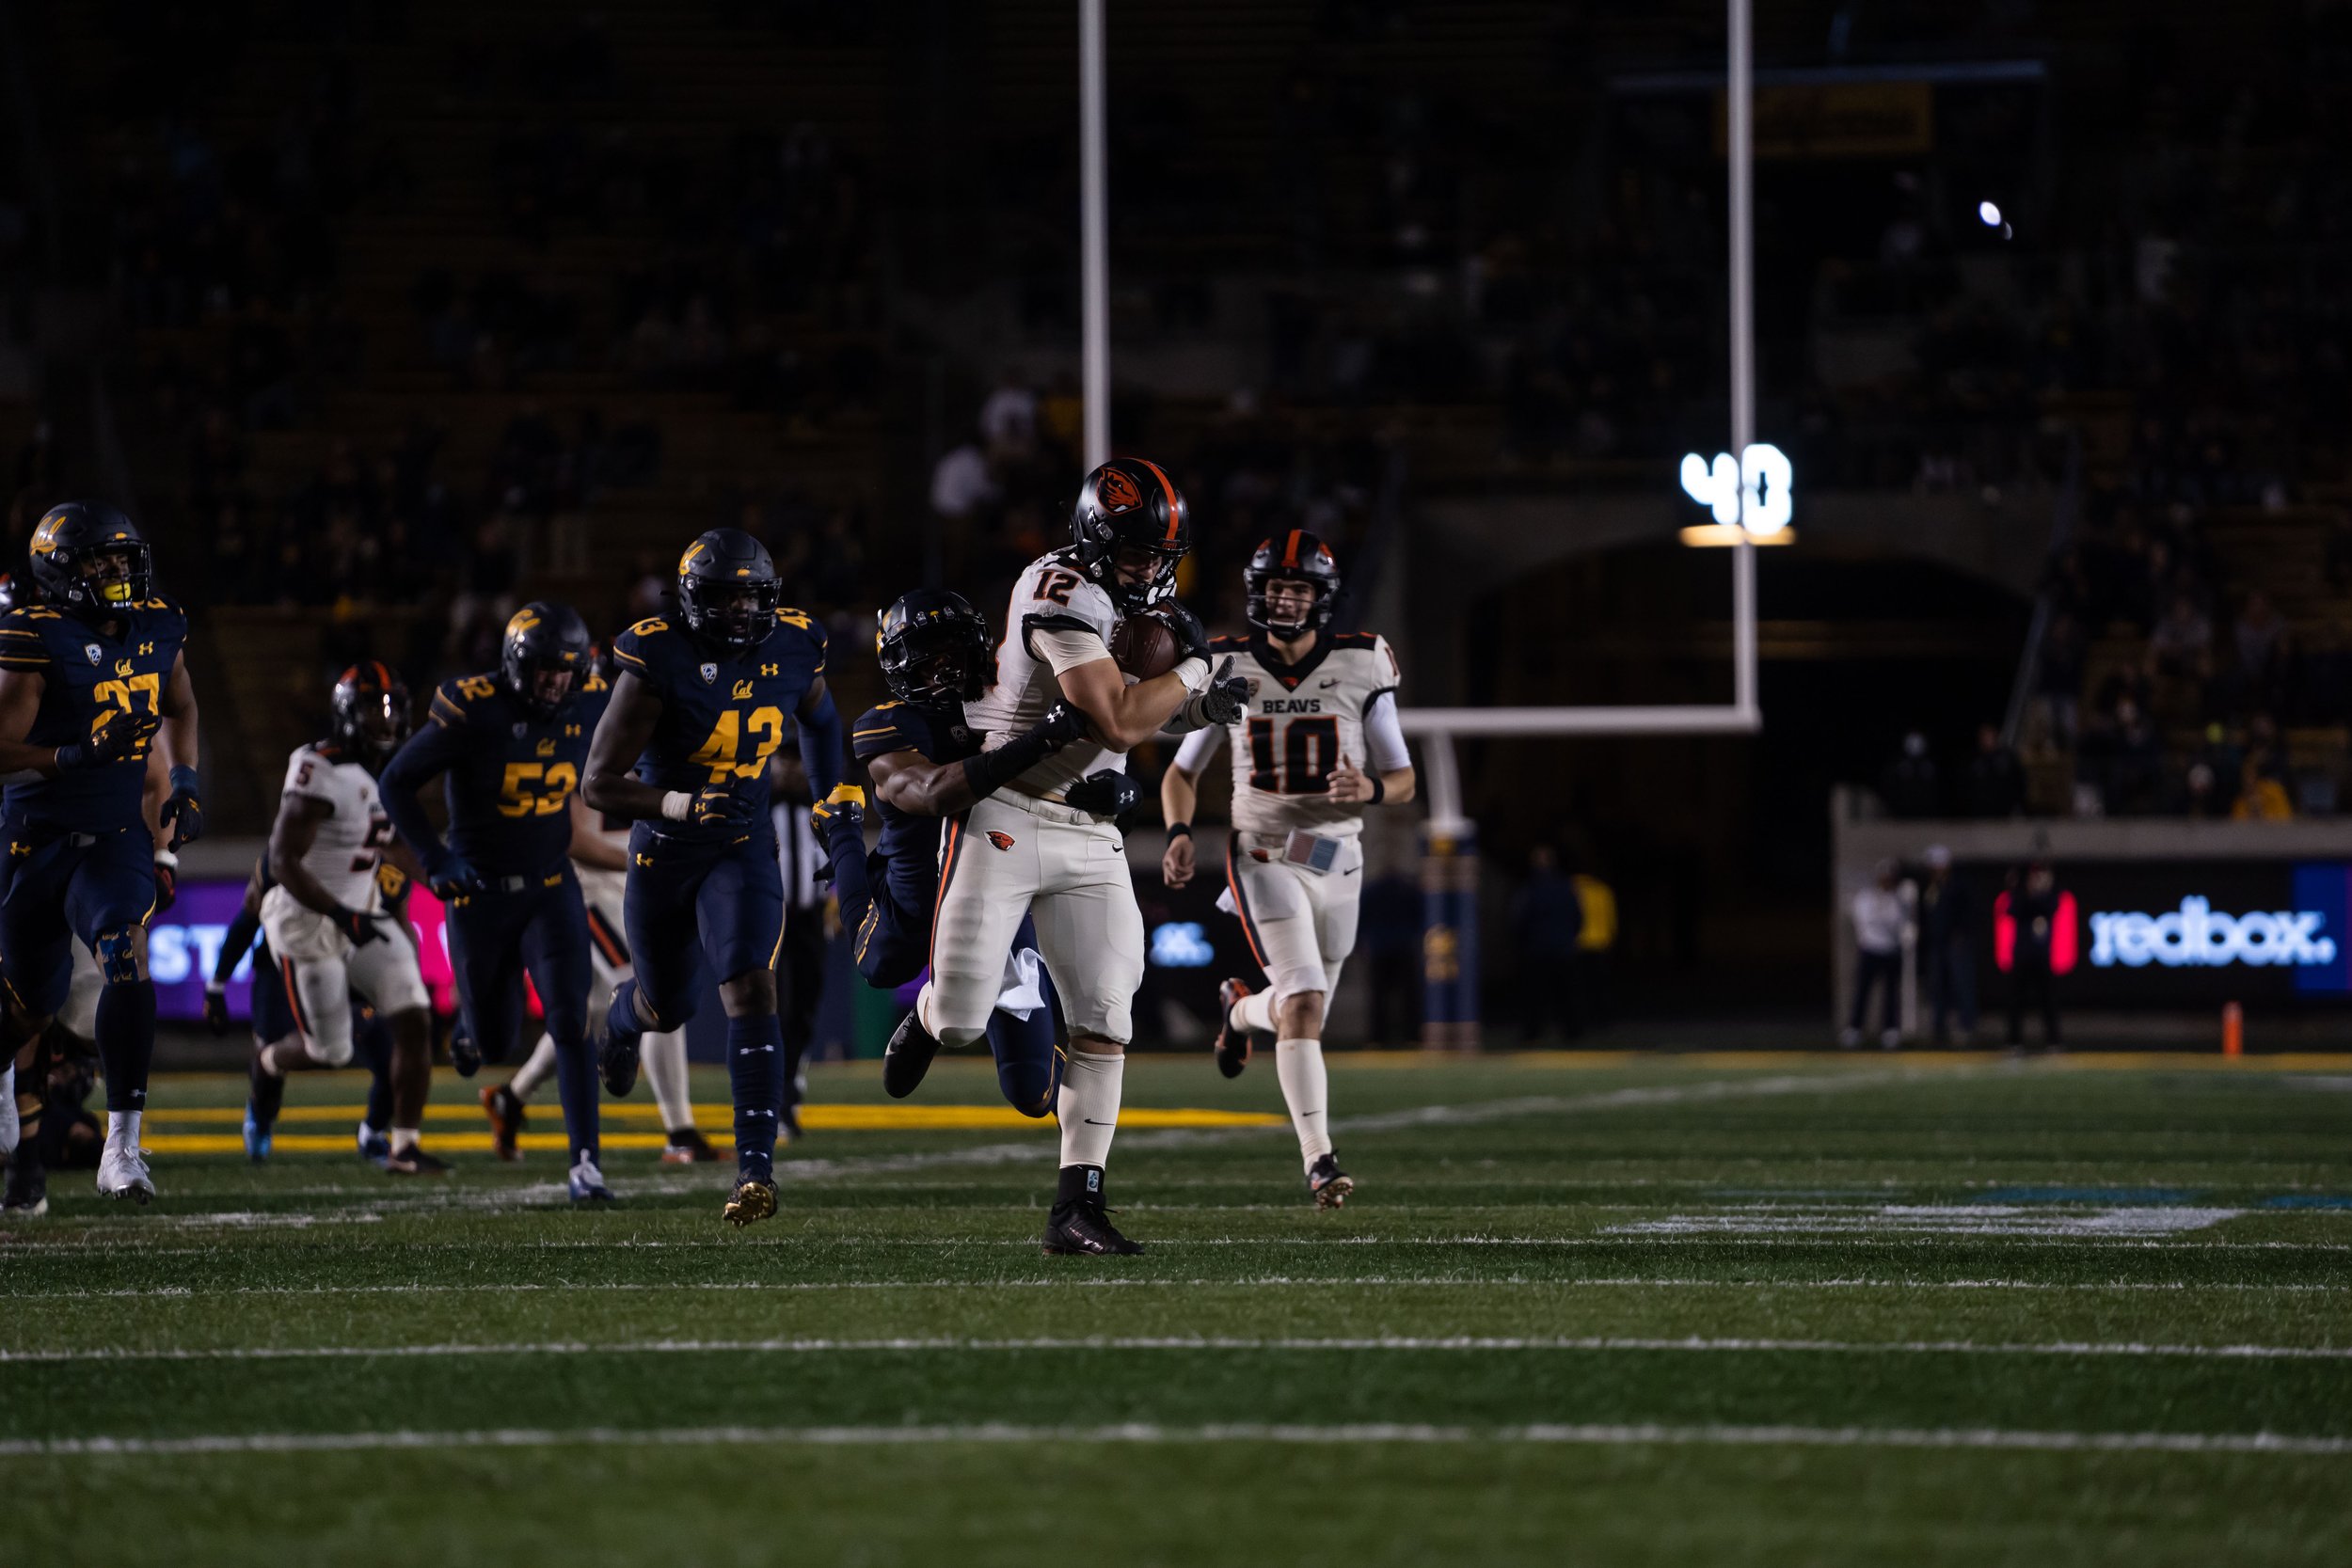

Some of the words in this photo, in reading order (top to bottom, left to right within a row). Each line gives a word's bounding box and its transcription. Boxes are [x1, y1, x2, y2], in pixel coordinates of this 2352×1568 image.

[1679, 443, 1792, 535] 40
[1033, 571, 1080, 608] 12
[114, 657, 135, 678] Cal
[732, 678, 754, 701] Cal
[1263, 699, 1321, 713] BEAVS
[686, 705, 784, 784] 43
[1248, 716, 1339, 795] 10
[497, 761, 578, 818] 52
